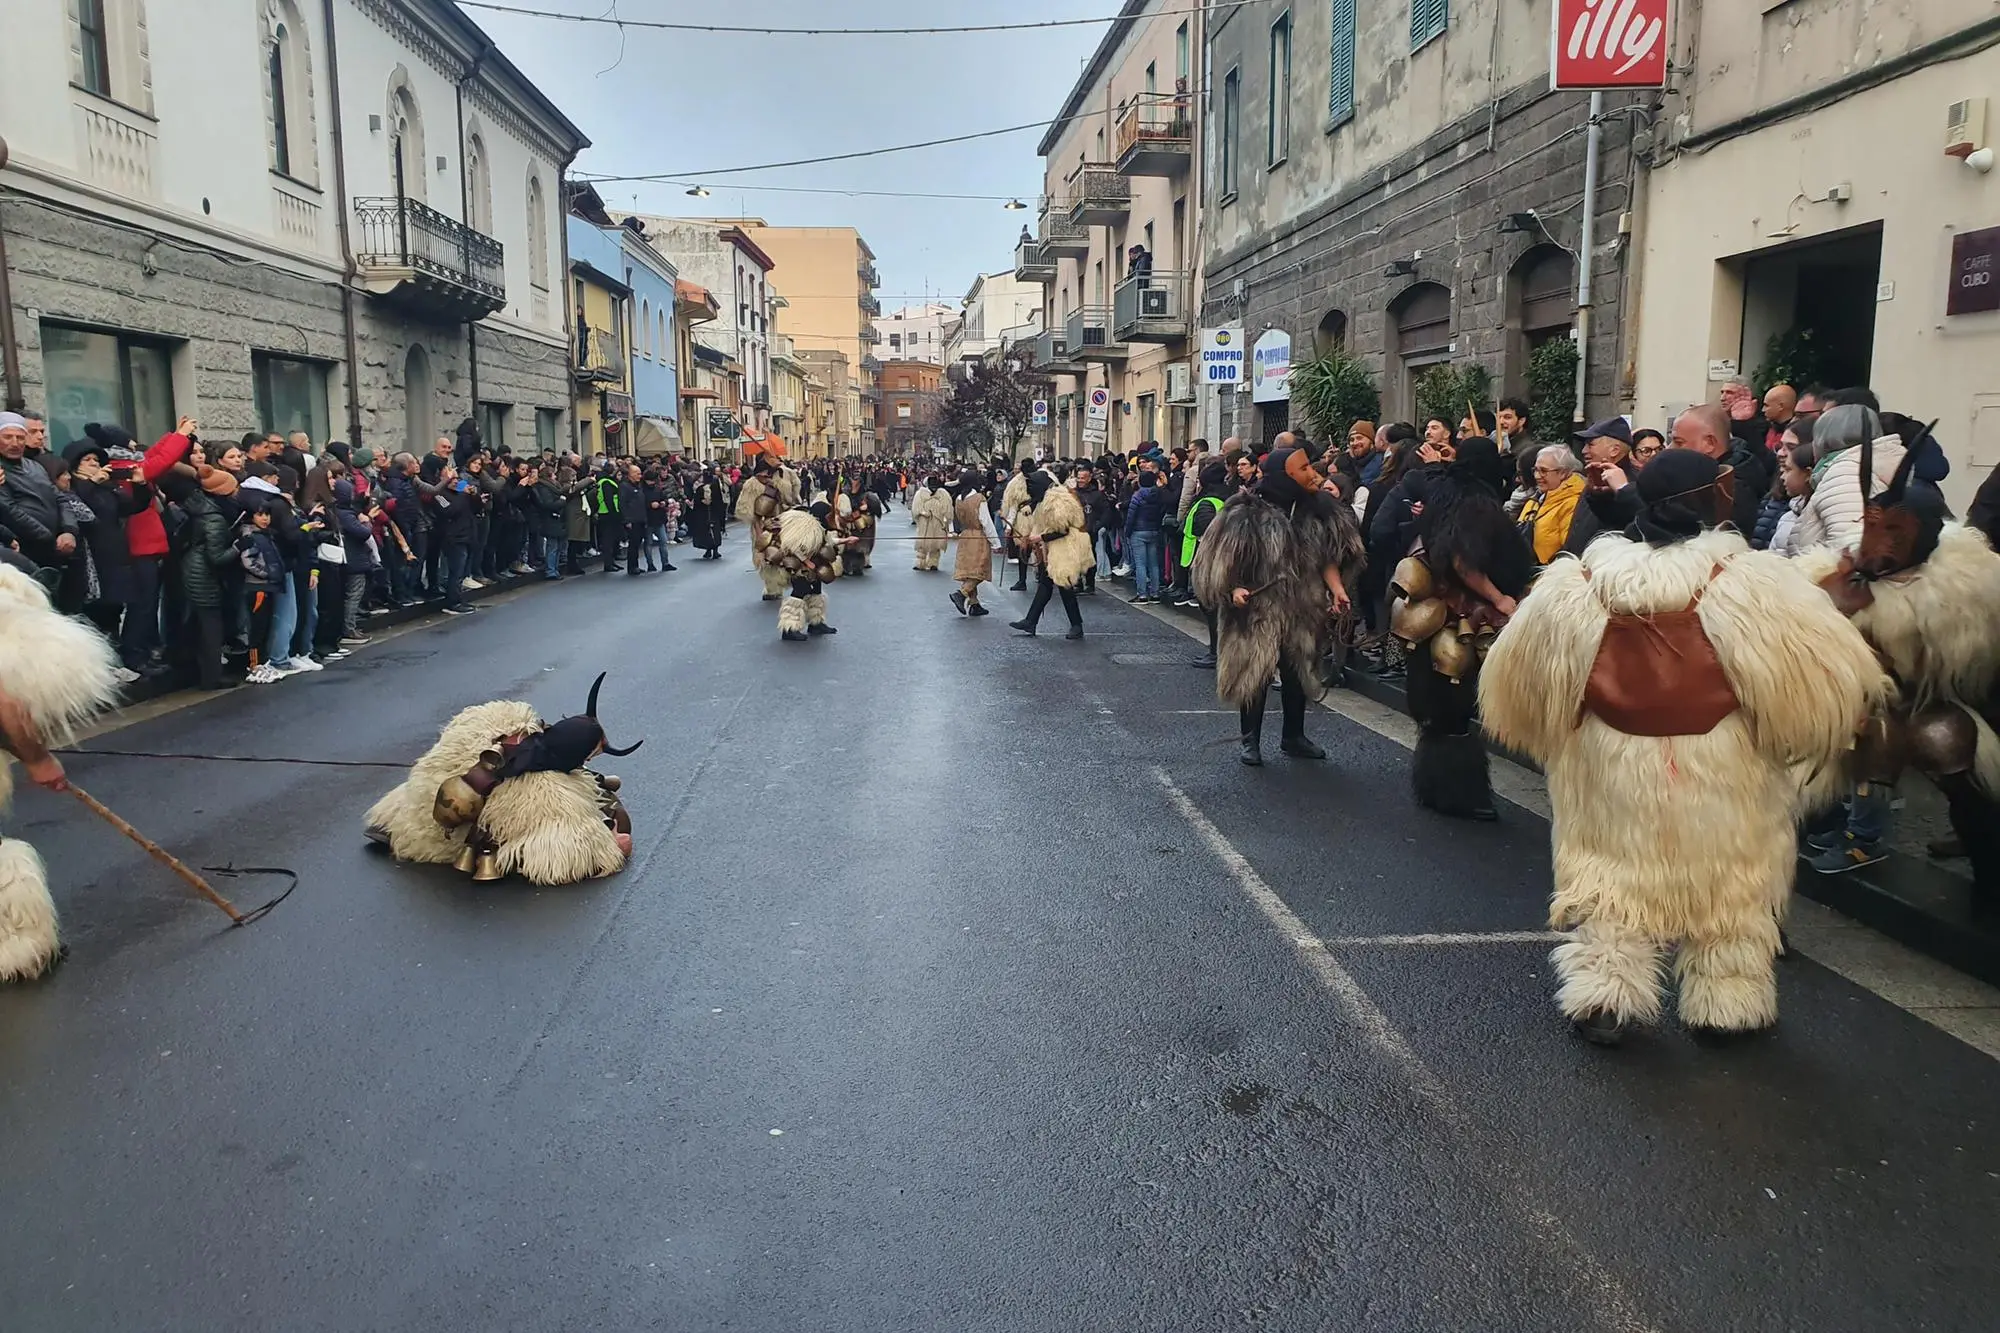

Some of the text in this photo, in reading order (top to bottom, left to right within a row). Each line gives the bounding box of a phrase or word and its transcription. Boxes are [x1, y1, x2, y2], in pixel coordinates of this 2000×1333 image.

[1567, 0, 1662, 76] illy
[1961, 271, 1990, 288] CUBO
[1216, 334, 1231, 343] ORO
[1203, 351, 1243, 361] COMPRO
[1209, 365, 1236, 380] ORO
